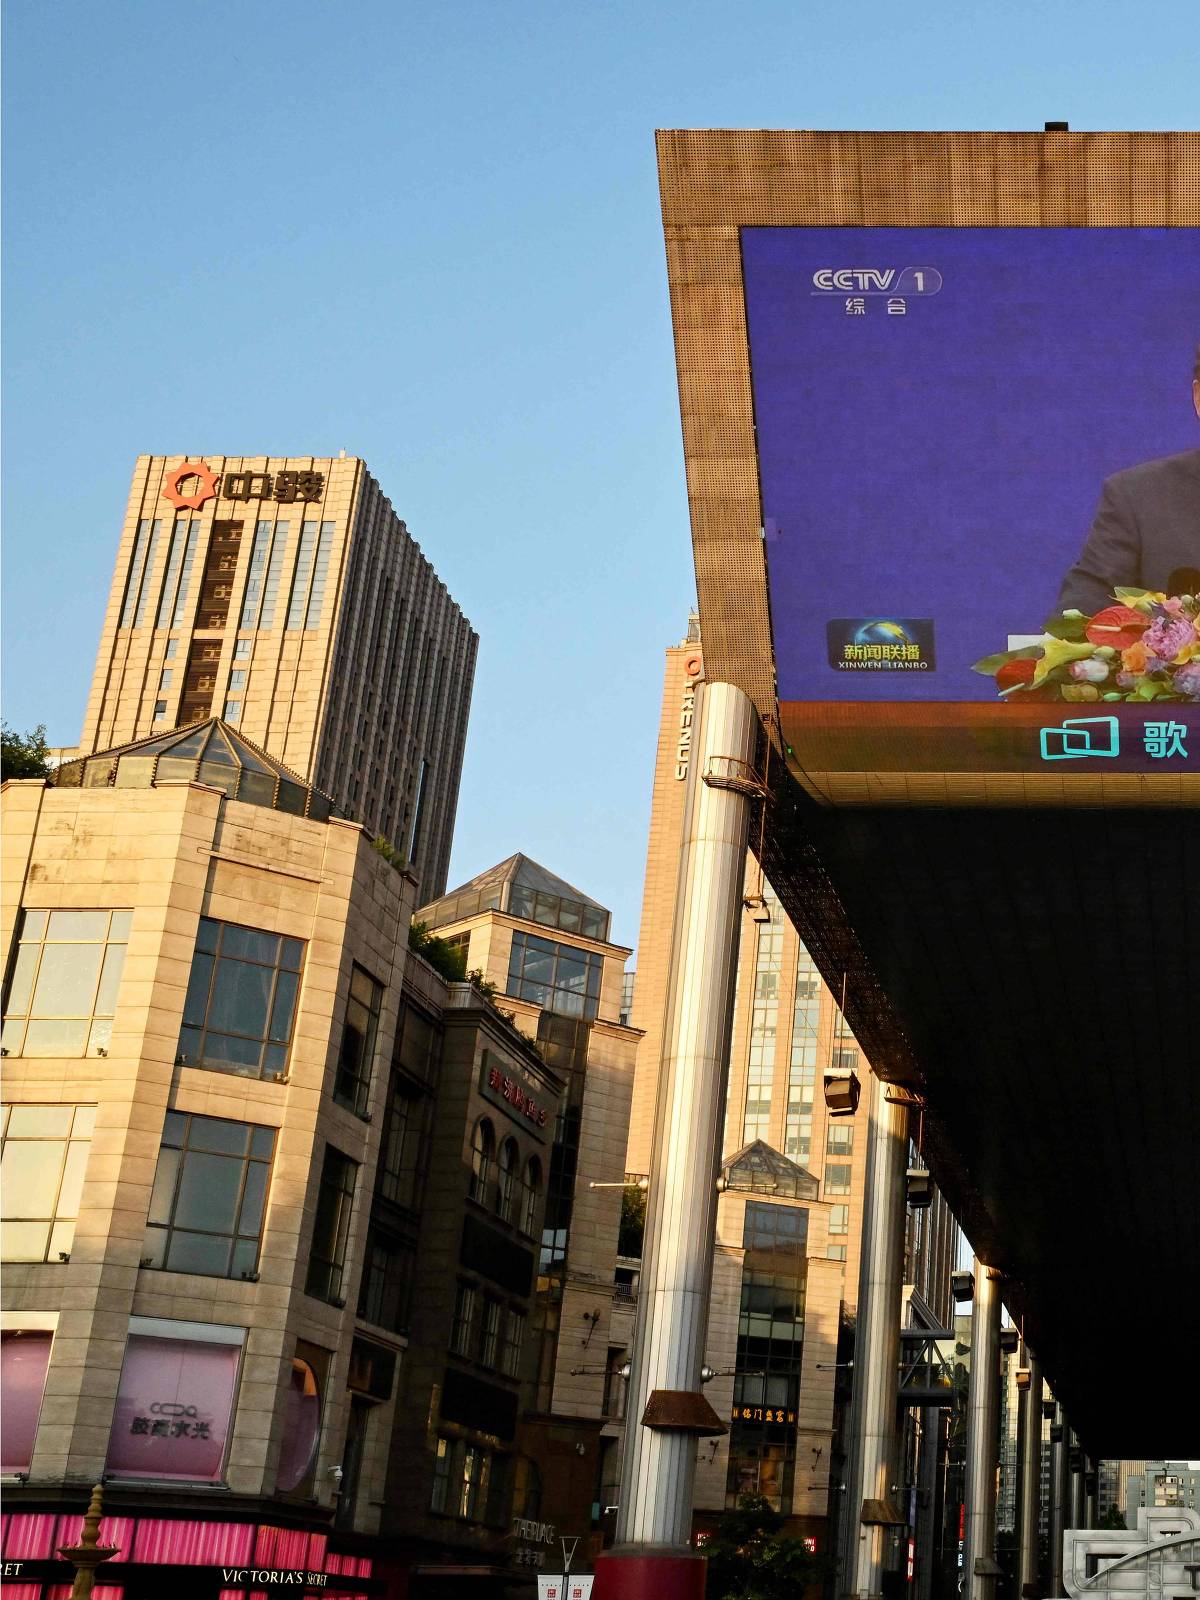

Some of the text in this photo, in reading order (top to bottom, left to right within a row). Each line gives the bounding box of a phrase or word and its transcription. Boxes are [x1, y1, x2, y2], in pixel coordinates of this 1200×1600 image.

[812, 269, 924, 292] CCTV 1
[222, 470, 326, 504] 中骏
[844, 644, 920, 660] 新闻联播
[838, 661, 928, 669] XINWEN LIANBO
[0, 1563, 24, 1576] ET
[223, 1568, 328, 1587] VICTORIA'S SECRET
